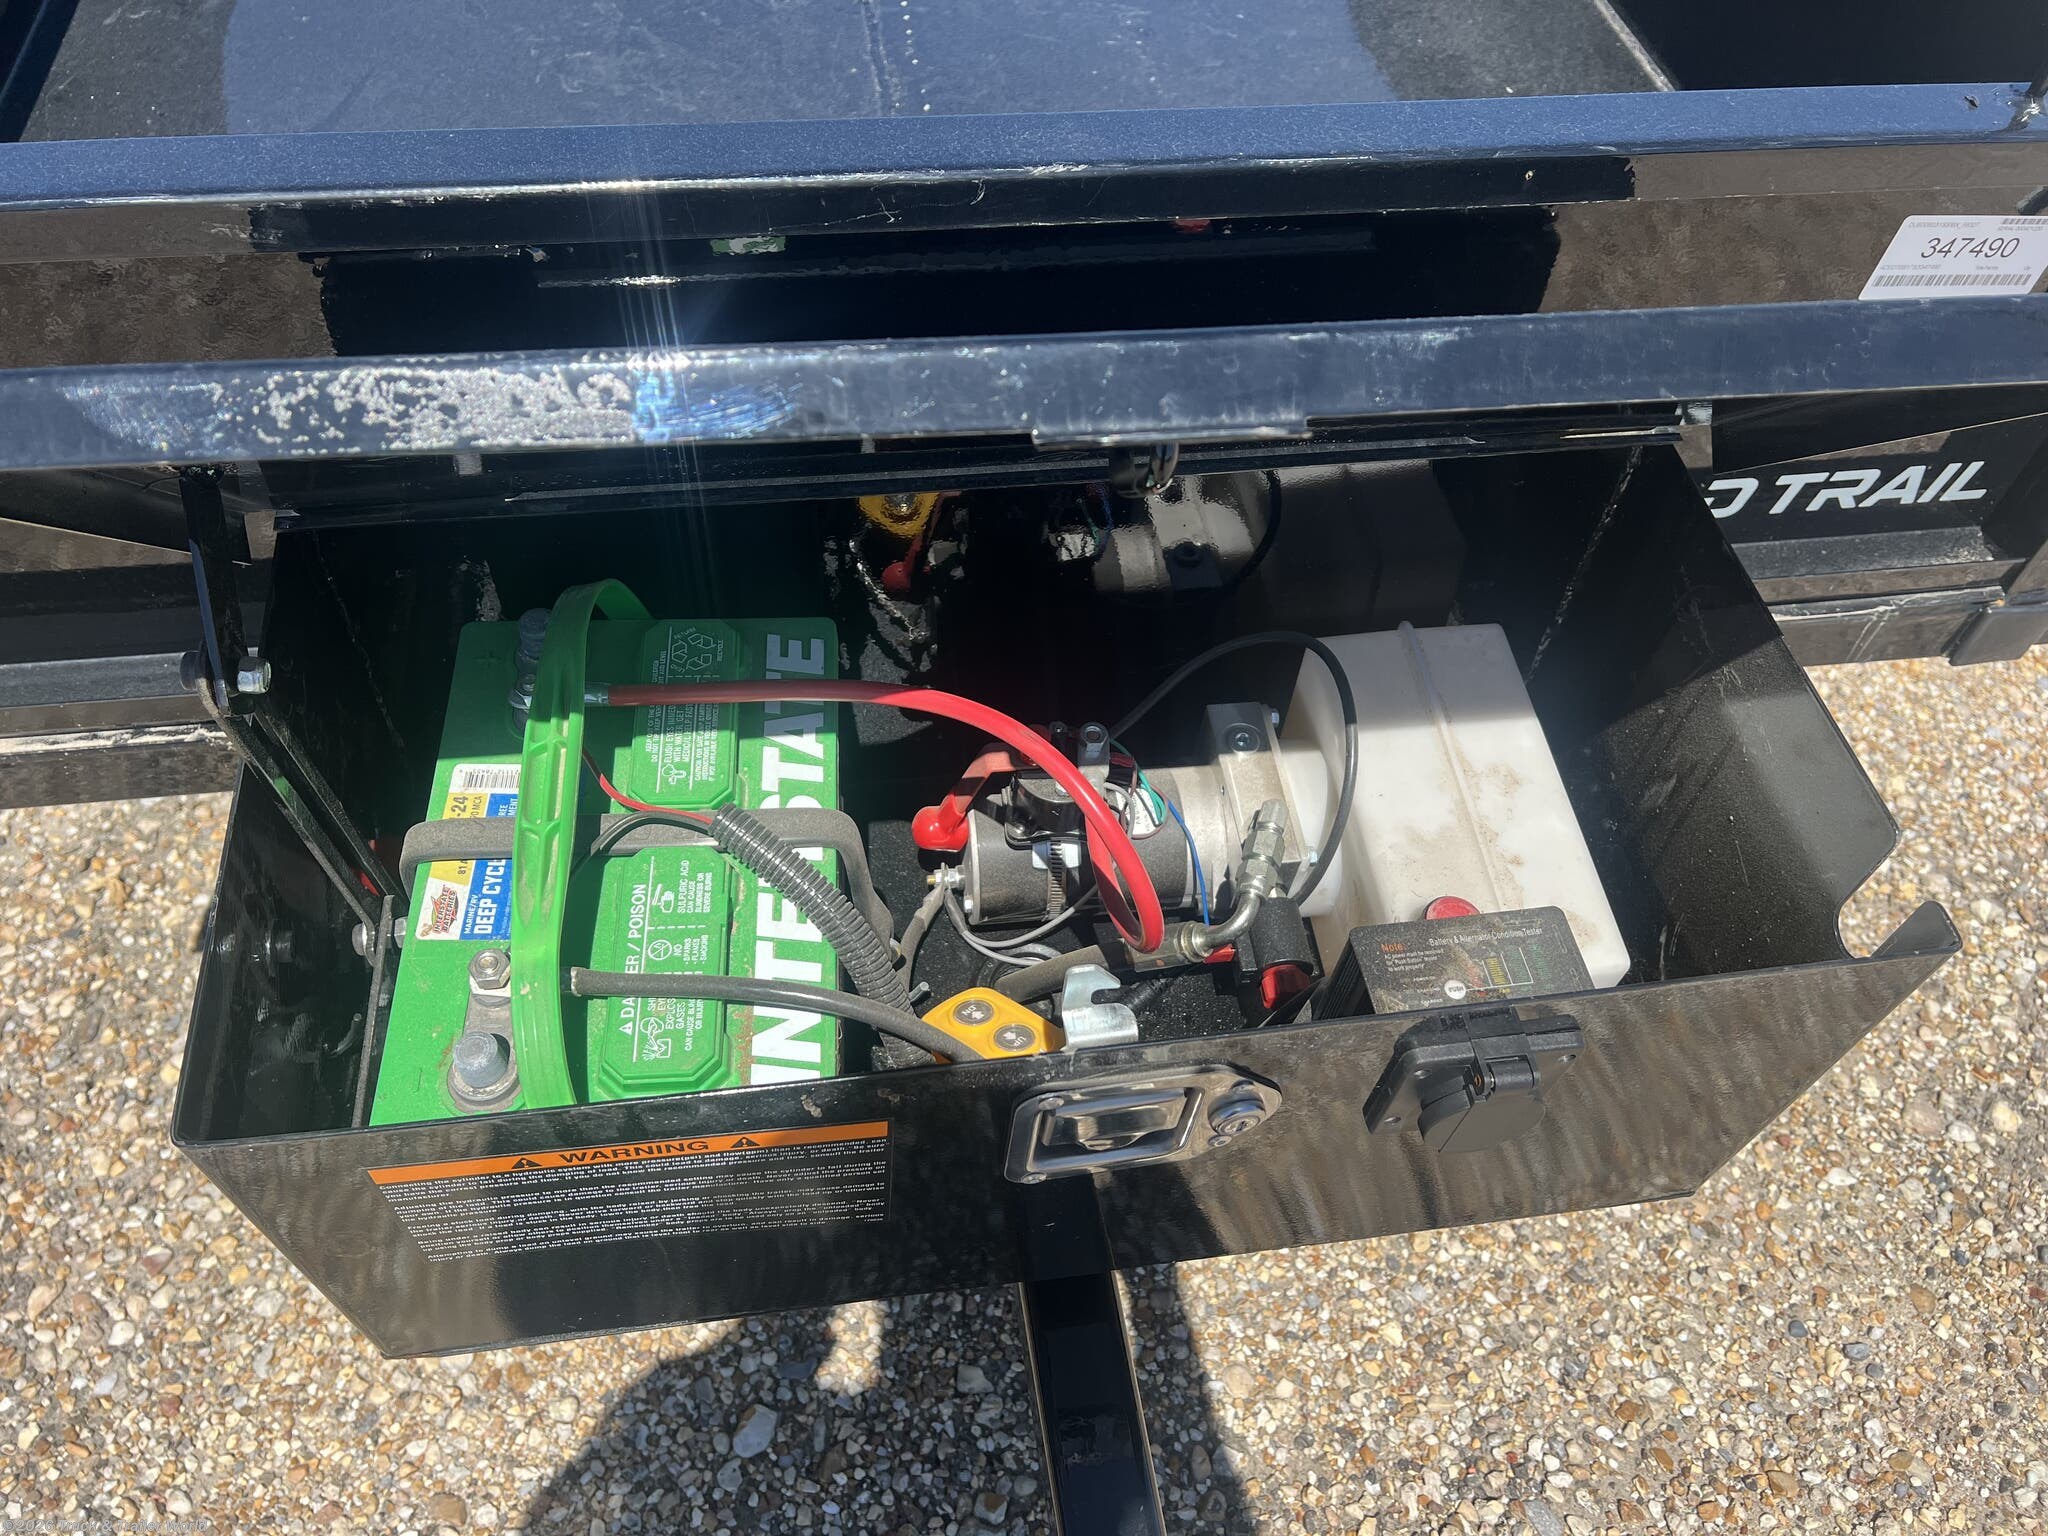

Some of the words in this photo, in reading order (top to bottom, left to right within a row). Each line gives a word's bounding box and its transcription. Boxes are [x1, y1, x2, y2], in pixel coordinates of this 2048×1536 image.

[1920, 237, 2020, 258] 347490
[1769, 460, 1988, 515] TRAIL
[666, 727, 674, 741] EYES
[664, 744, 673, 763] FLUSH
[674, 747, 682, 762] WITH
[682, 736, 691, 762] MEDICAL
[498, 804, 508, 816] REE
[481, 859, 507, 895] CYCL
[680, 860, 689, 876] ACID
[678, 878, 688, 913] SULFURIC
[688, 881, 696, 901] CAUSE
[433, 887, 450, 933] INTERSTATE
[441, 890, 456, 933] BATTERIES
[628, 884, 646, 938] POISON
[687, 903, 695, 913] CAN
[704, 892, 712, 912] SEVERE
[464, 895, 478, 934] MARINE/RV
[473, 898, 497, 934] DEEP
[1522, 928, 1543, 936] Tester
[628, 943, 640, 951] /
[674, 944, 683, 956] NO
[700, 935, 709, 961] SMOKING
[621, 955, 640, 1018] DAER
[665, 998, 676, 1030] EXPLOS
[676, 1002, 685, 1029] GASES
[686, 1016, 694, 1036] CAUSE
[685, 1036, 693, 1051] CAN
[1013, 1036, 1027, 1047] UP
[559, 1141, 709, 1163] WARNING
